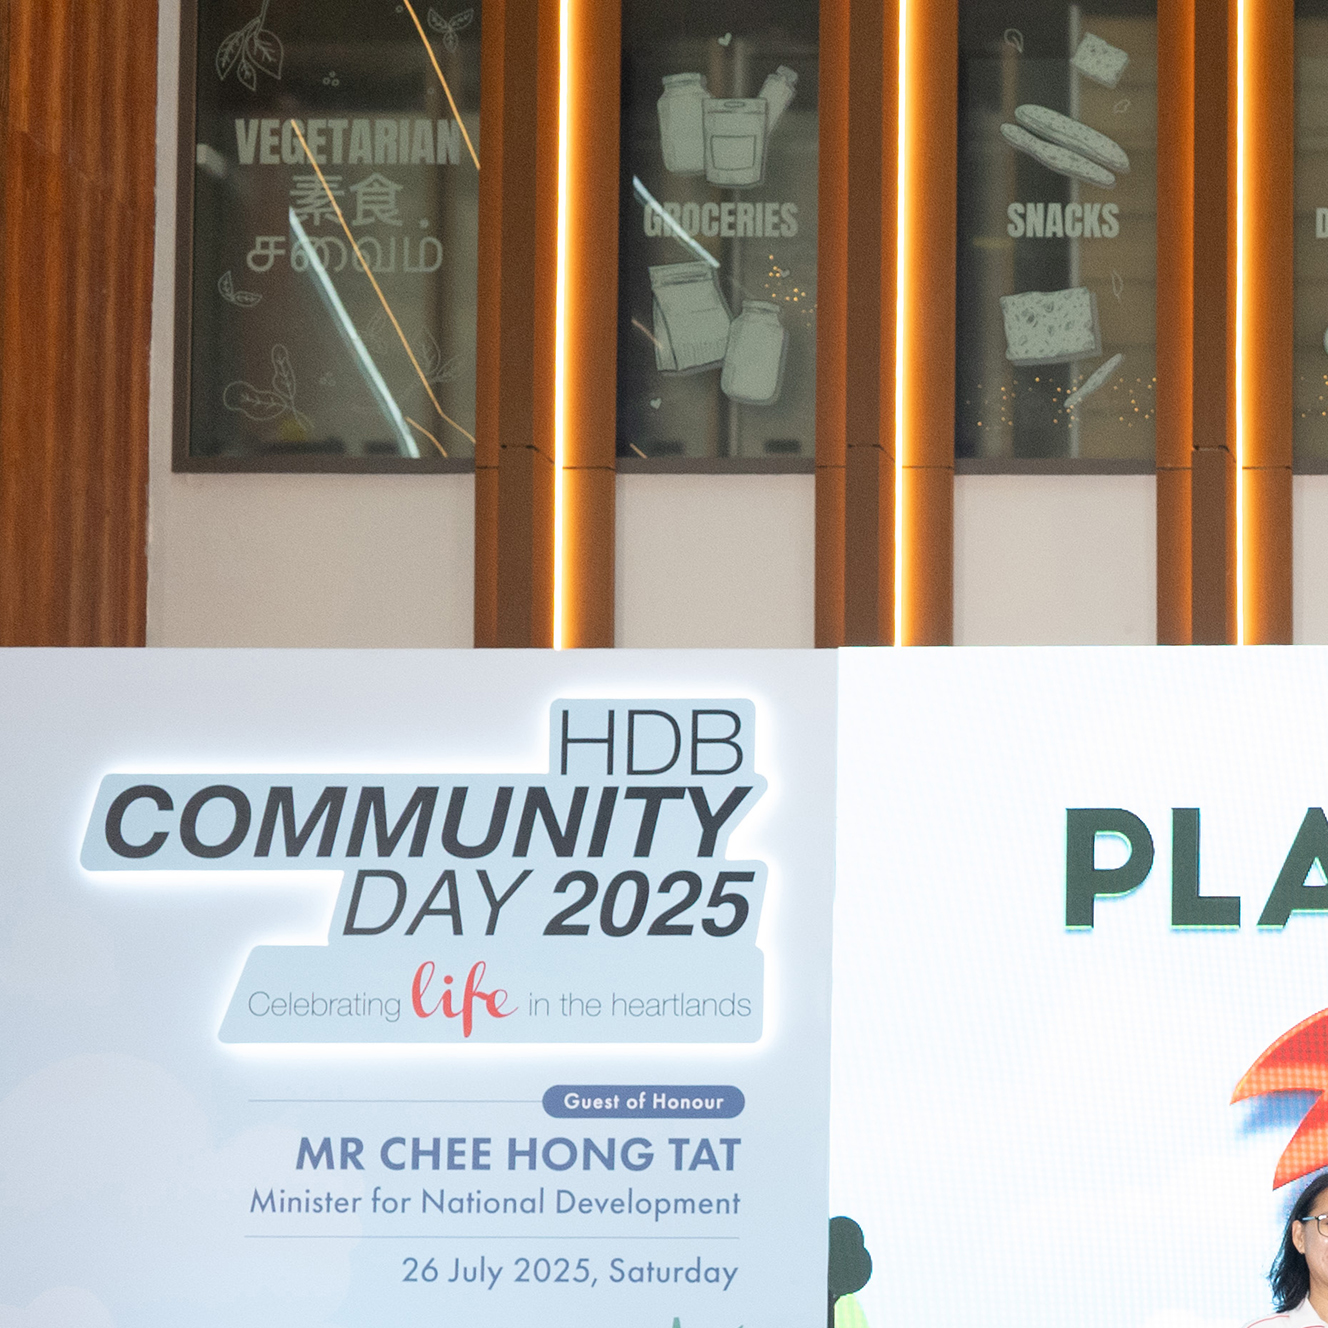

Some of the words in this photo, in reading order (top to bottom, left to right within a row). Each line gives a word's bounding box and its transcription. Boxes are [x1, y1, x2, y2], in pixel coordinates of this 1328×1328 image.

[235, 118, 460, 165] VEGETARIAN
[290, 172, 403, 226] 素食
[643, 201, 799, 238] GROCERIES
[1006, 202, 1120, 238] SNACKS
[560, 708, 744, 776] HDB
[104, 784, 754, 859] COMMUNITY
[342, 869, 534, 936] DAY
[542, 870, 755, 938] 2025
[247, 990, 401, 1022] Celebrating
[410, 960, 519, 1038] life
[528, 992, 550, 1017] in
[558, 990, 601, 1018] the
[611, 990, 752, 1018] heartlands
[564, 1092, 620, 1110] Guest
[626, 1091, 646, 1110] of
[652, 1092, 724, 1110] Honour
[295, 1137, 365, 1171] MR
[379, 1136, 492, 1171] CHEE
[507, 1136, 654, 1171] HONG
[668, 1137, 742, 1171] TAT
[249, 1187, 362, 1214] Minister
[370, 1187, 412, 1214] for
[422, 1187, 545, 1215] National
[556, 1187, 741, 1222] Development
[401, 1257, 439, 1284] 26
[448, 1256, 503, 1290] July
[513, 1256, 598, 1289] 2025,
[609, 1256, 739, 1292] Saturday
